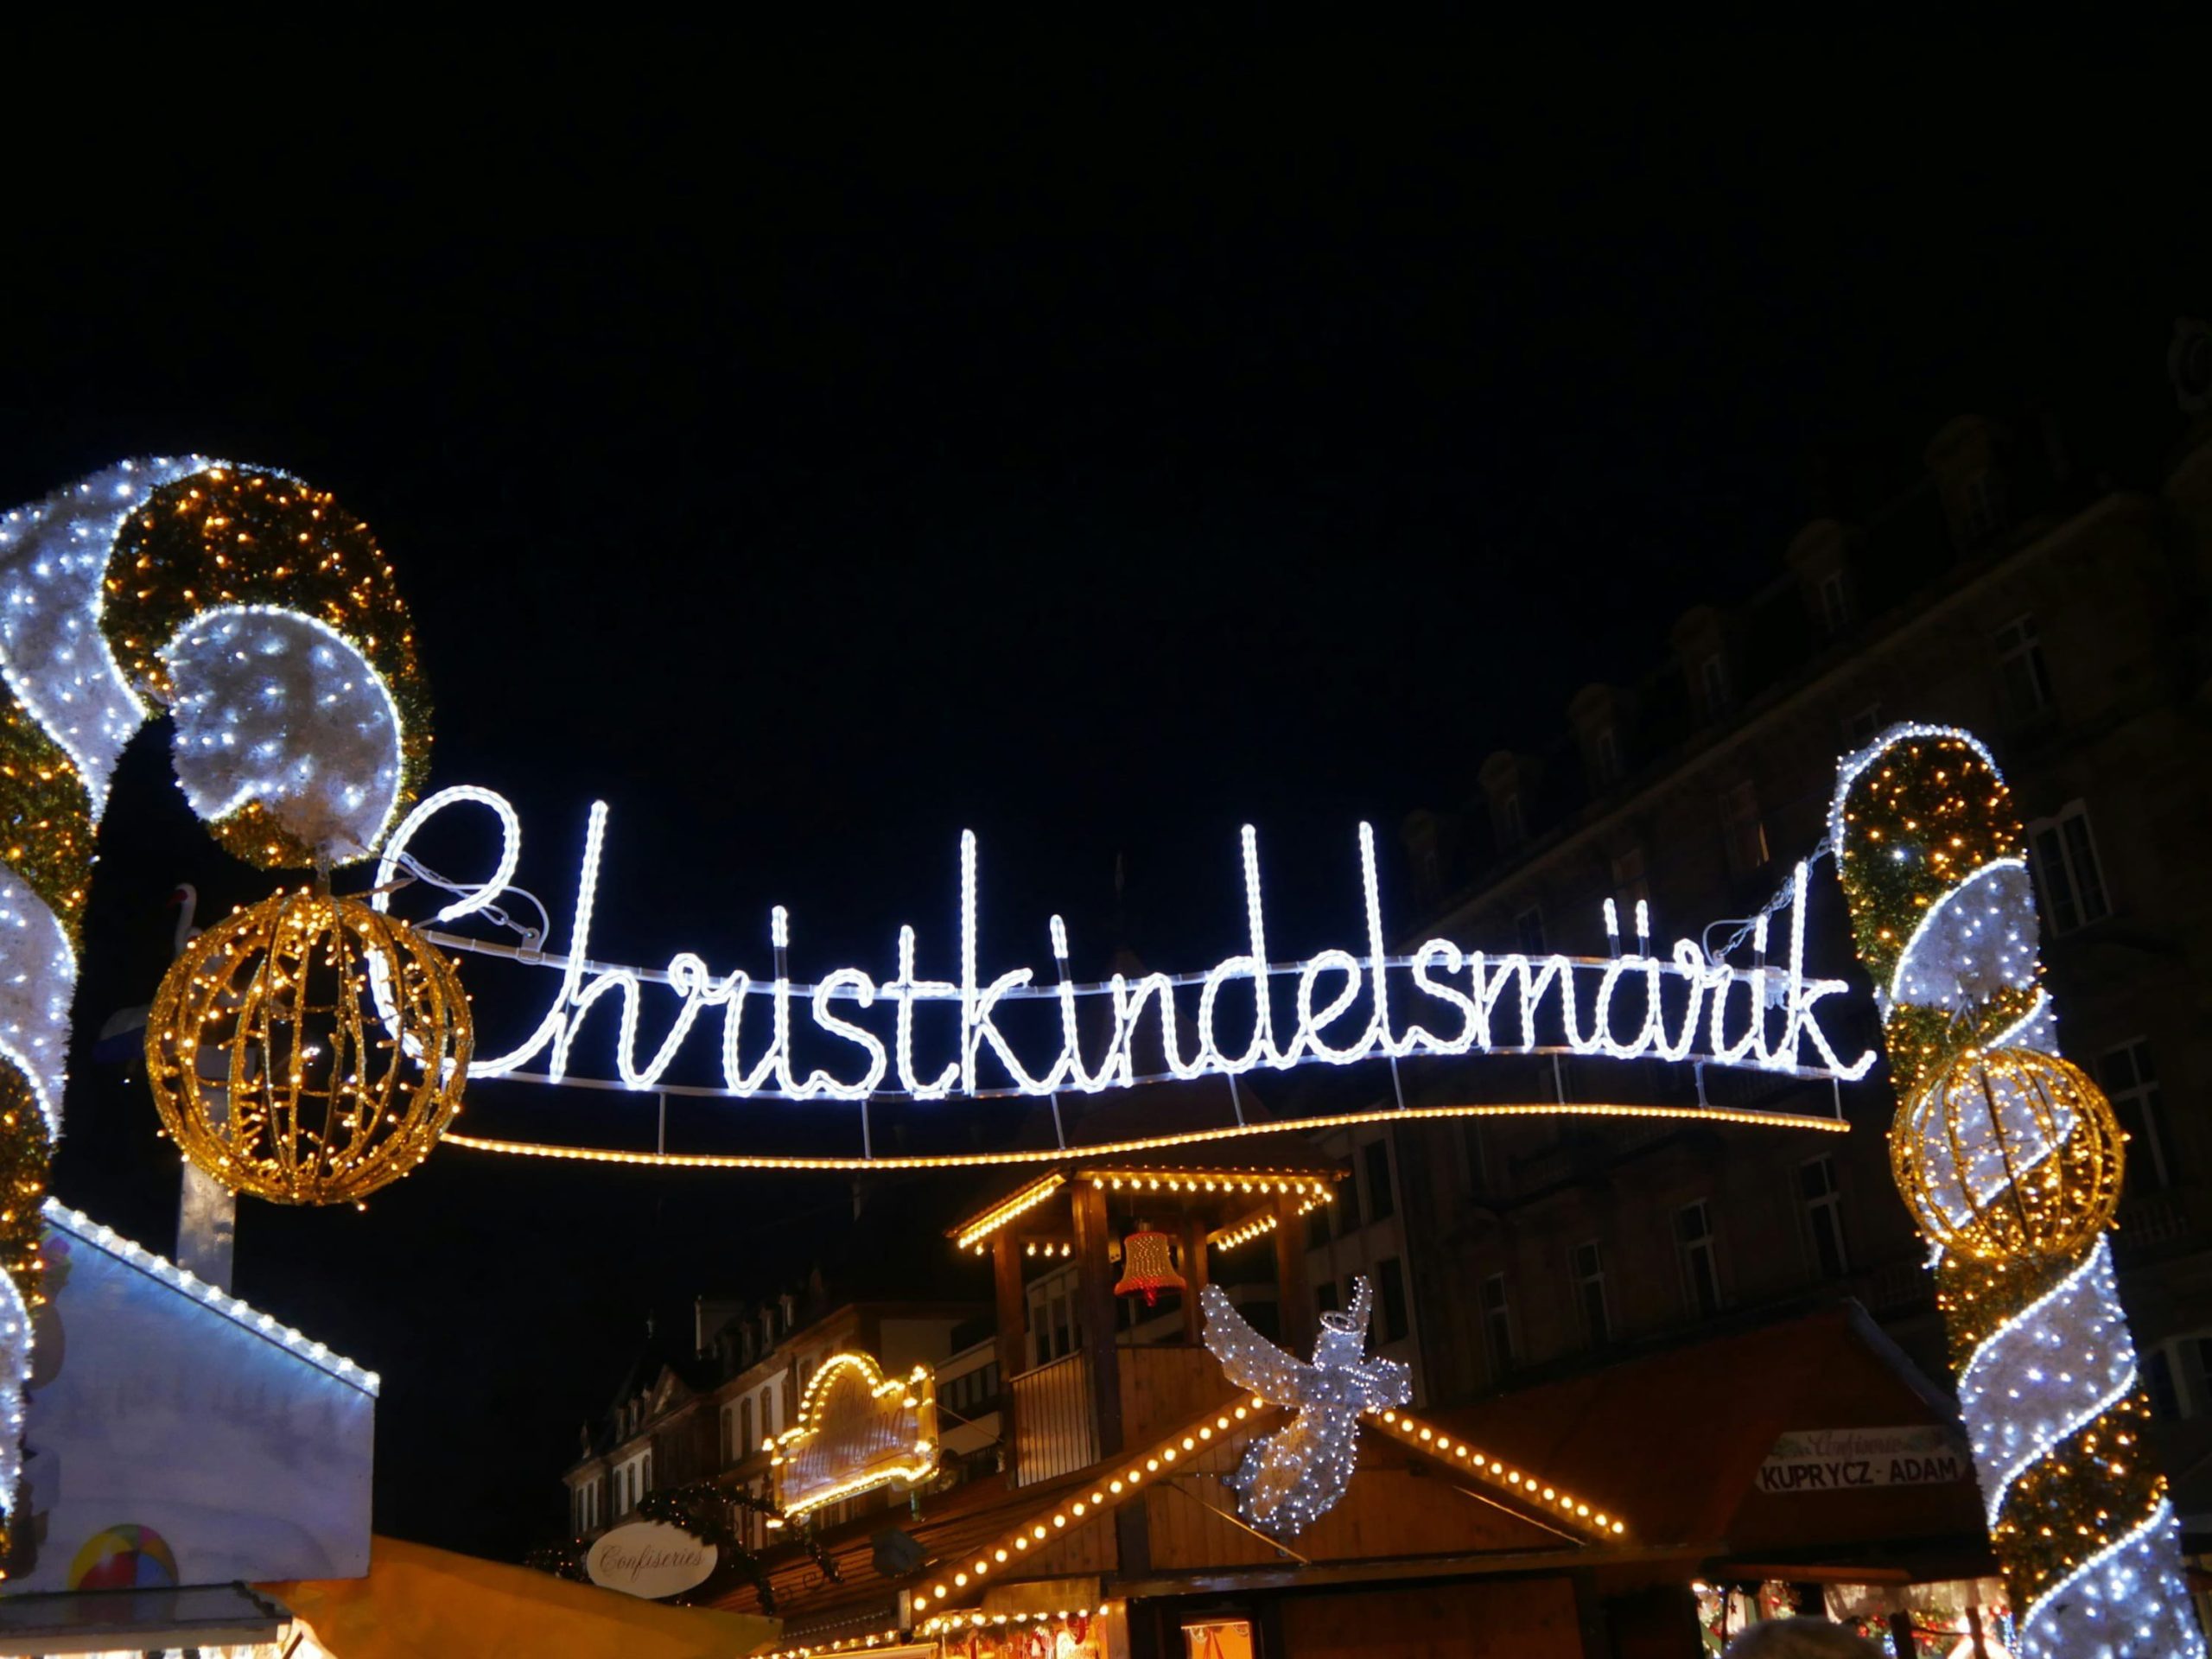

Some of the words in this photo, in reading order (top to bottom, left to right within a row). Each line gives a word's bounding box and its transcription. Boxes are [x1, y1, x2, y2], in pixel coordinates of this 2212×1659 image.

[1761, 1461, 1872, 1490] KUPRYCZ
[1890, 1457, 1957, 1483] ADAM
[599, 1544, 705, 1582] Confiseries
